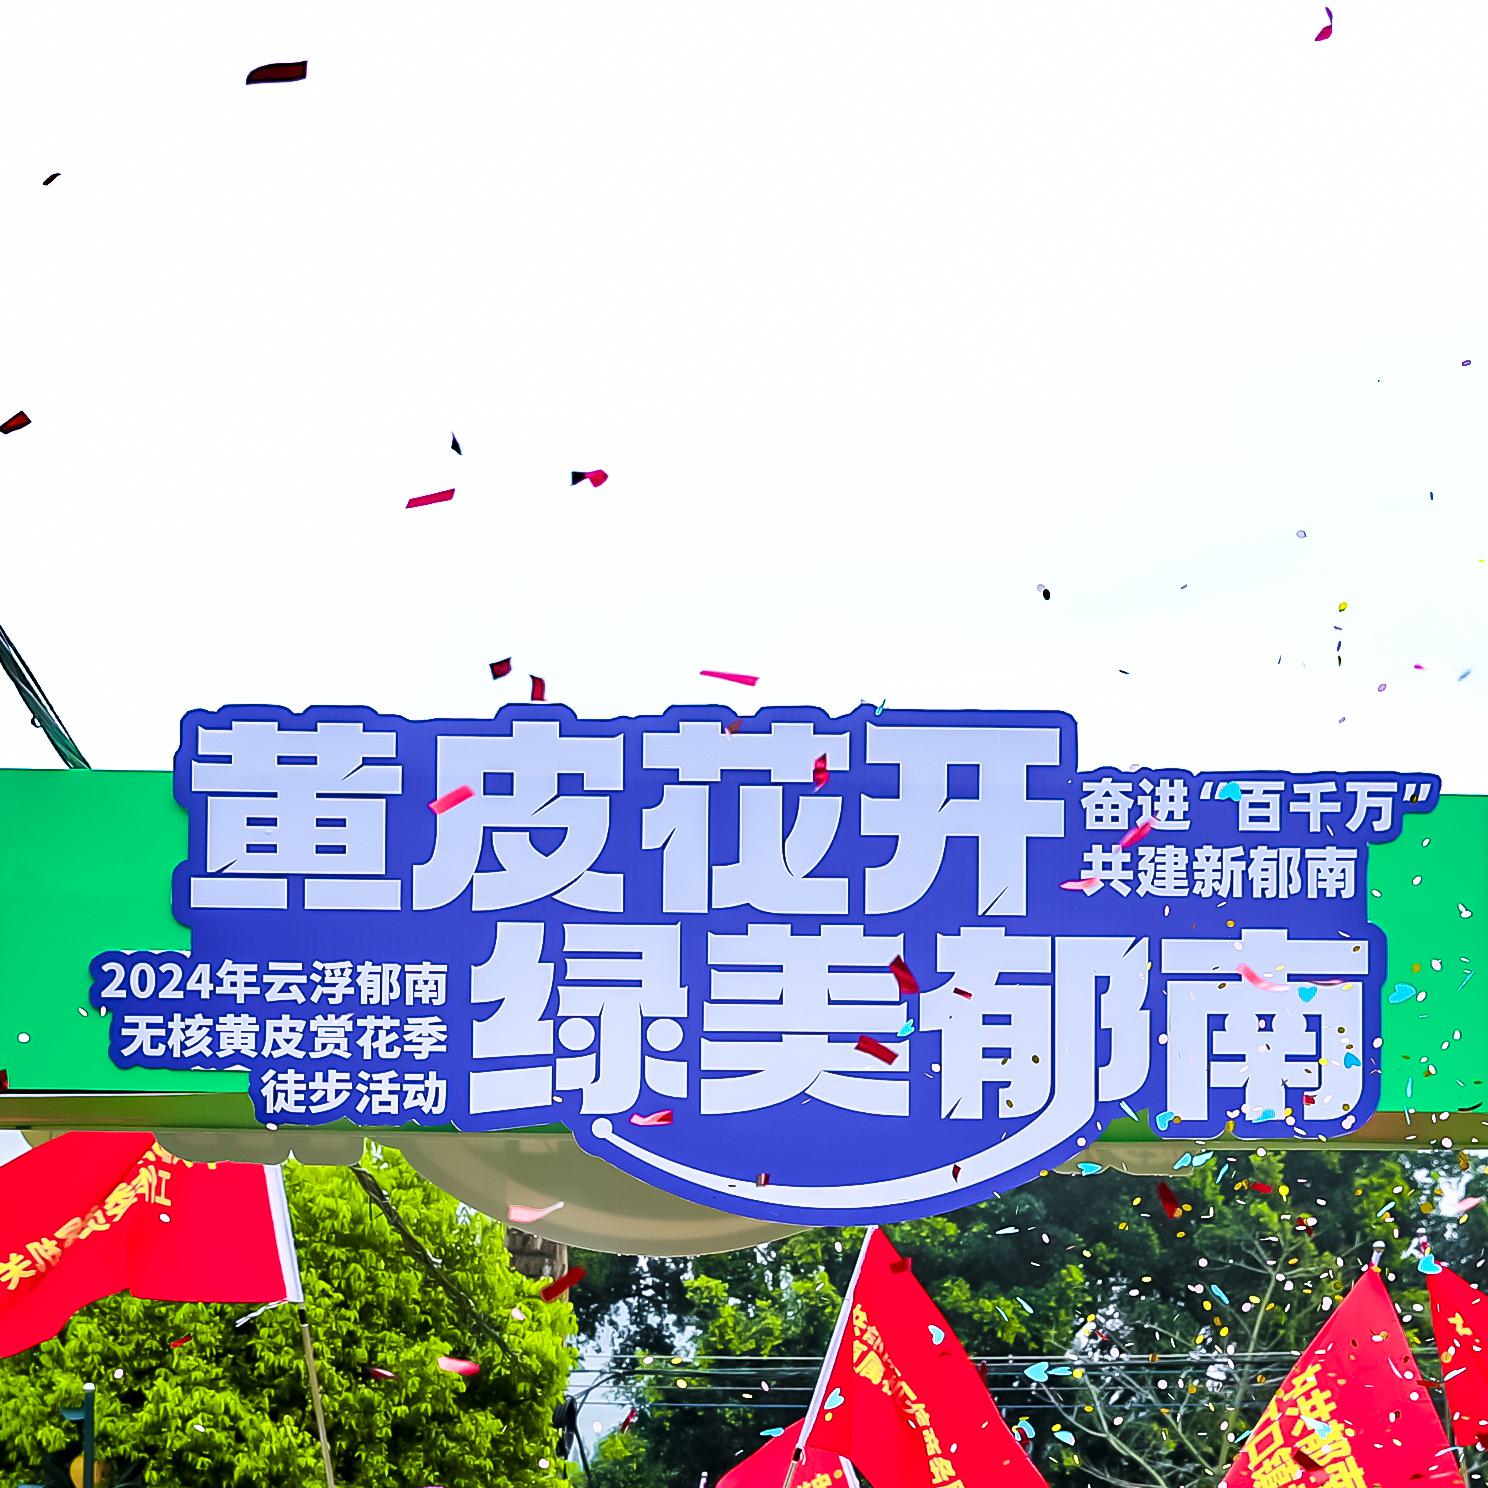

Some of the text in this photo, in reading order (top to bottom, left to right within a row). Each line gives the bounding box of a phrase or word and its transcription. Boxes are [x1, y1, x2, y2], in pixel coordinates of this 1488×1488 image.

[191, 720, 1064, 916] 黄皮花开
[1079, 845, 1358, 899] 共建新郁南
[101, 959, 448, 1006] 2024年云浮郁南
[120, 1013, 448, 1060] 无核黄皮赏花季
[469, 922, 1369, 1121] 绿美郁南
[260, 1068, 448, 1115] 徒步活动
